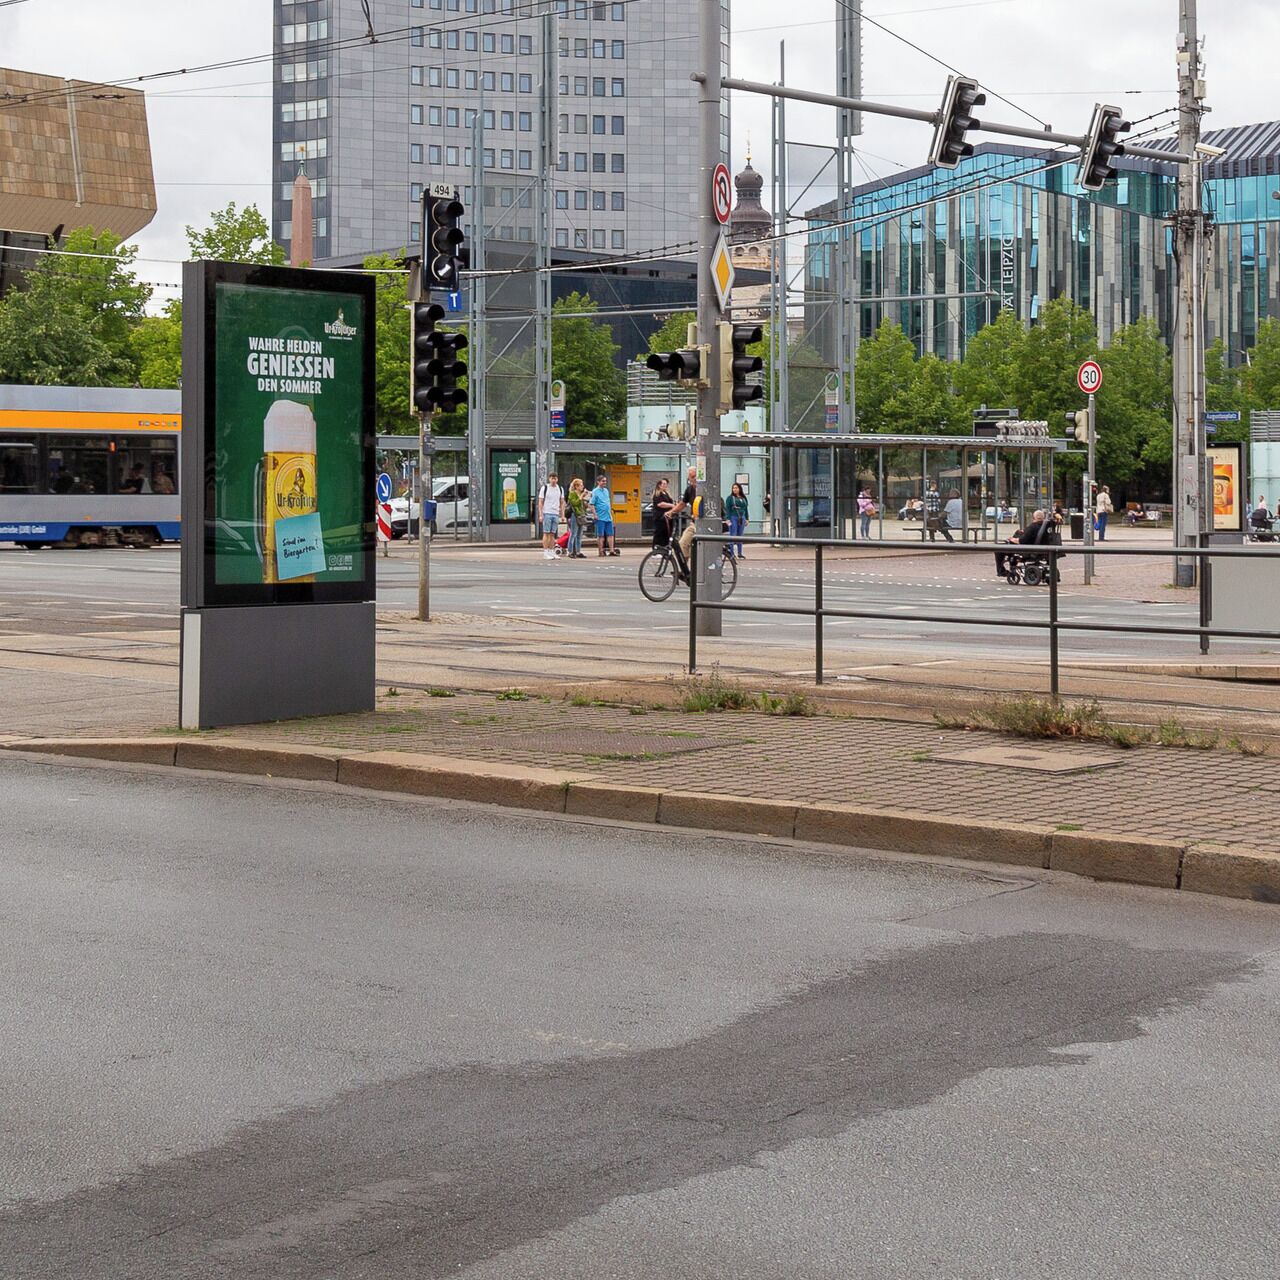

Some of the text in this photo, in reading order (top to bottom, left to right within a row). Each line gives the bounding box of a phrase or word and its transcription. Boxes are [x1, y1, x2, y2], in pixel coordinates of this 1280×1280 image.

[433, 184, 451, 196] 494
[450, 292, 458, 308] T
[248, 336, 322, 355] WAHRE HELDEN
[247, 353, 335, 379] GENIESSEN
[1082, 370, 1097, 384] 30
[257, 377, 322, 394] DEN SOMMER
